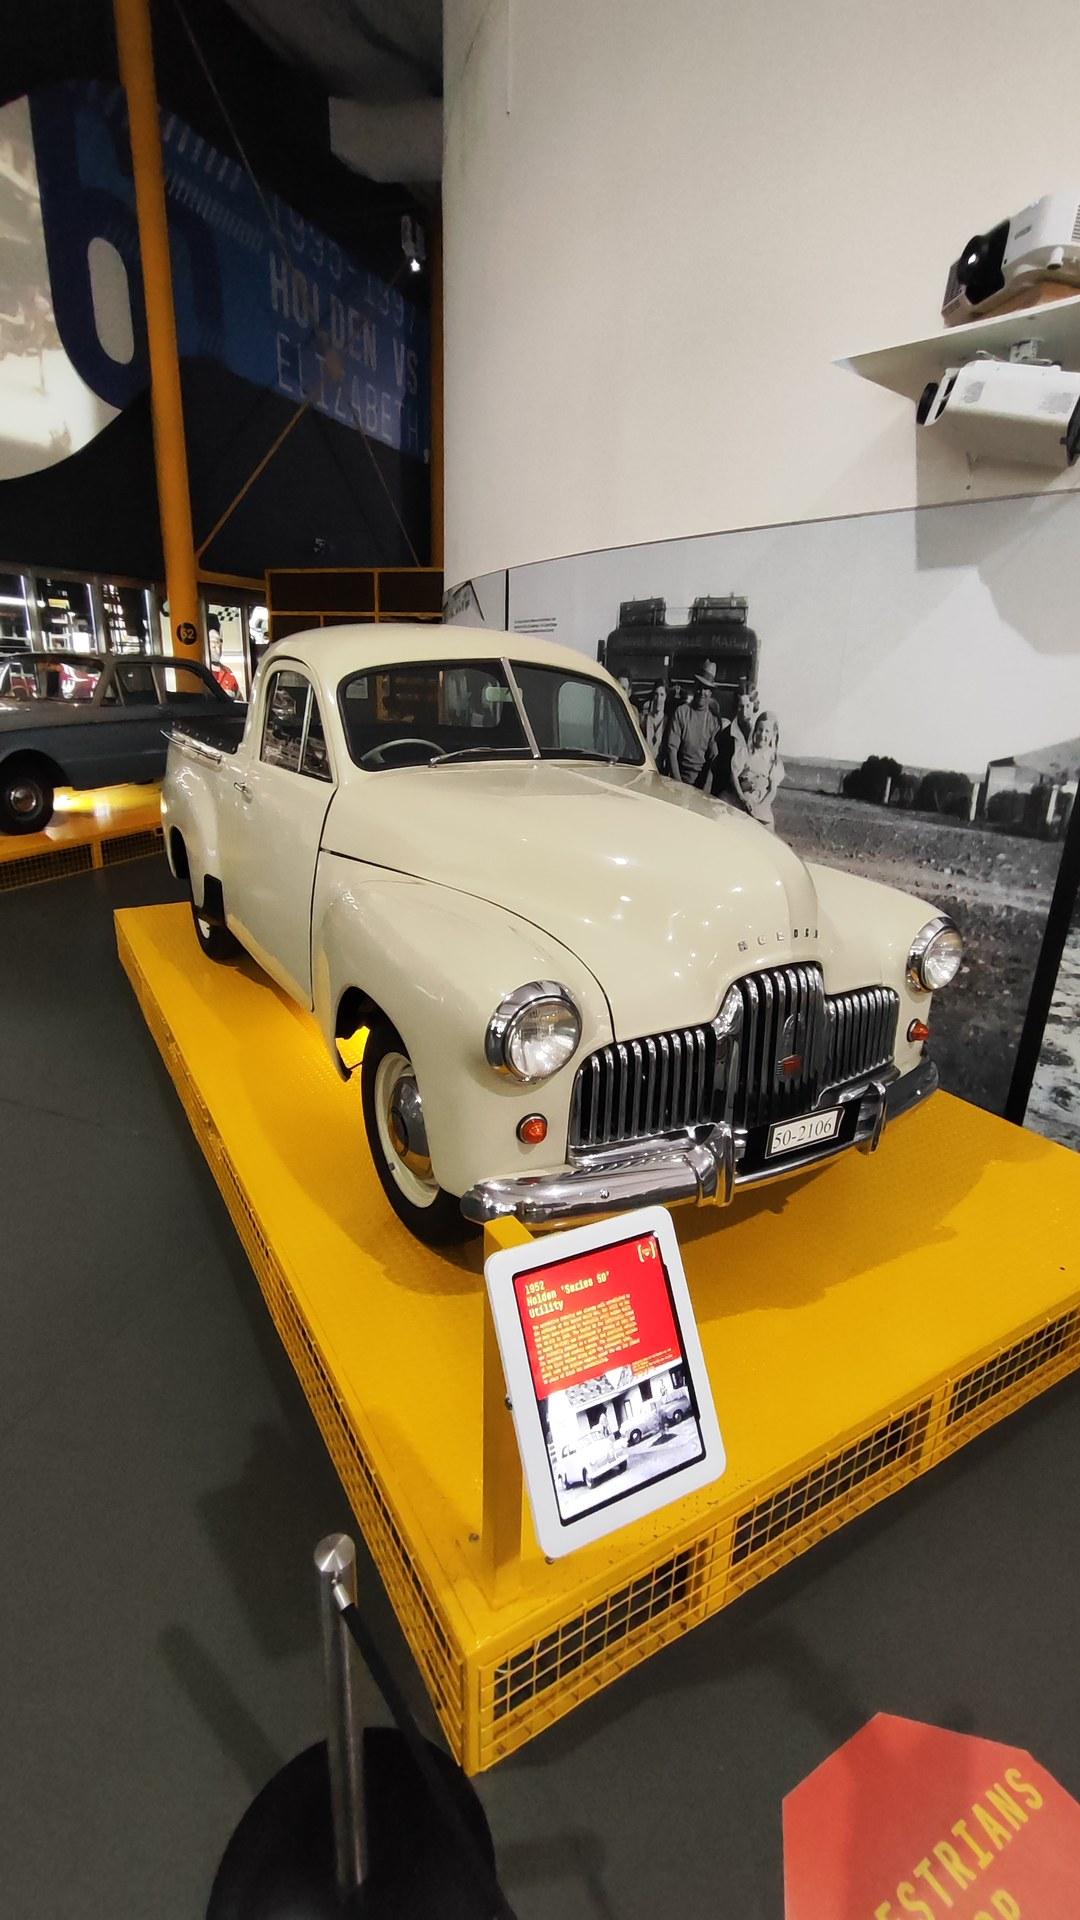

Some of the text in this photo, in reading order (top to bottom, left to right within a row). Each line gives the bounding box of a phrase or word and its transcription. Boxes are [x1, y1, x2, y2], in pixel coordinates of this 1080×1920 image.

[391, 336, 418, 395] VS
[773, 1116, 832, 1149] 50-2106
[525, 1280, 545, 1295] 1952
[527, 1289, 557, 1307] Holden
[528, 1299, 564, 1319] Utility
